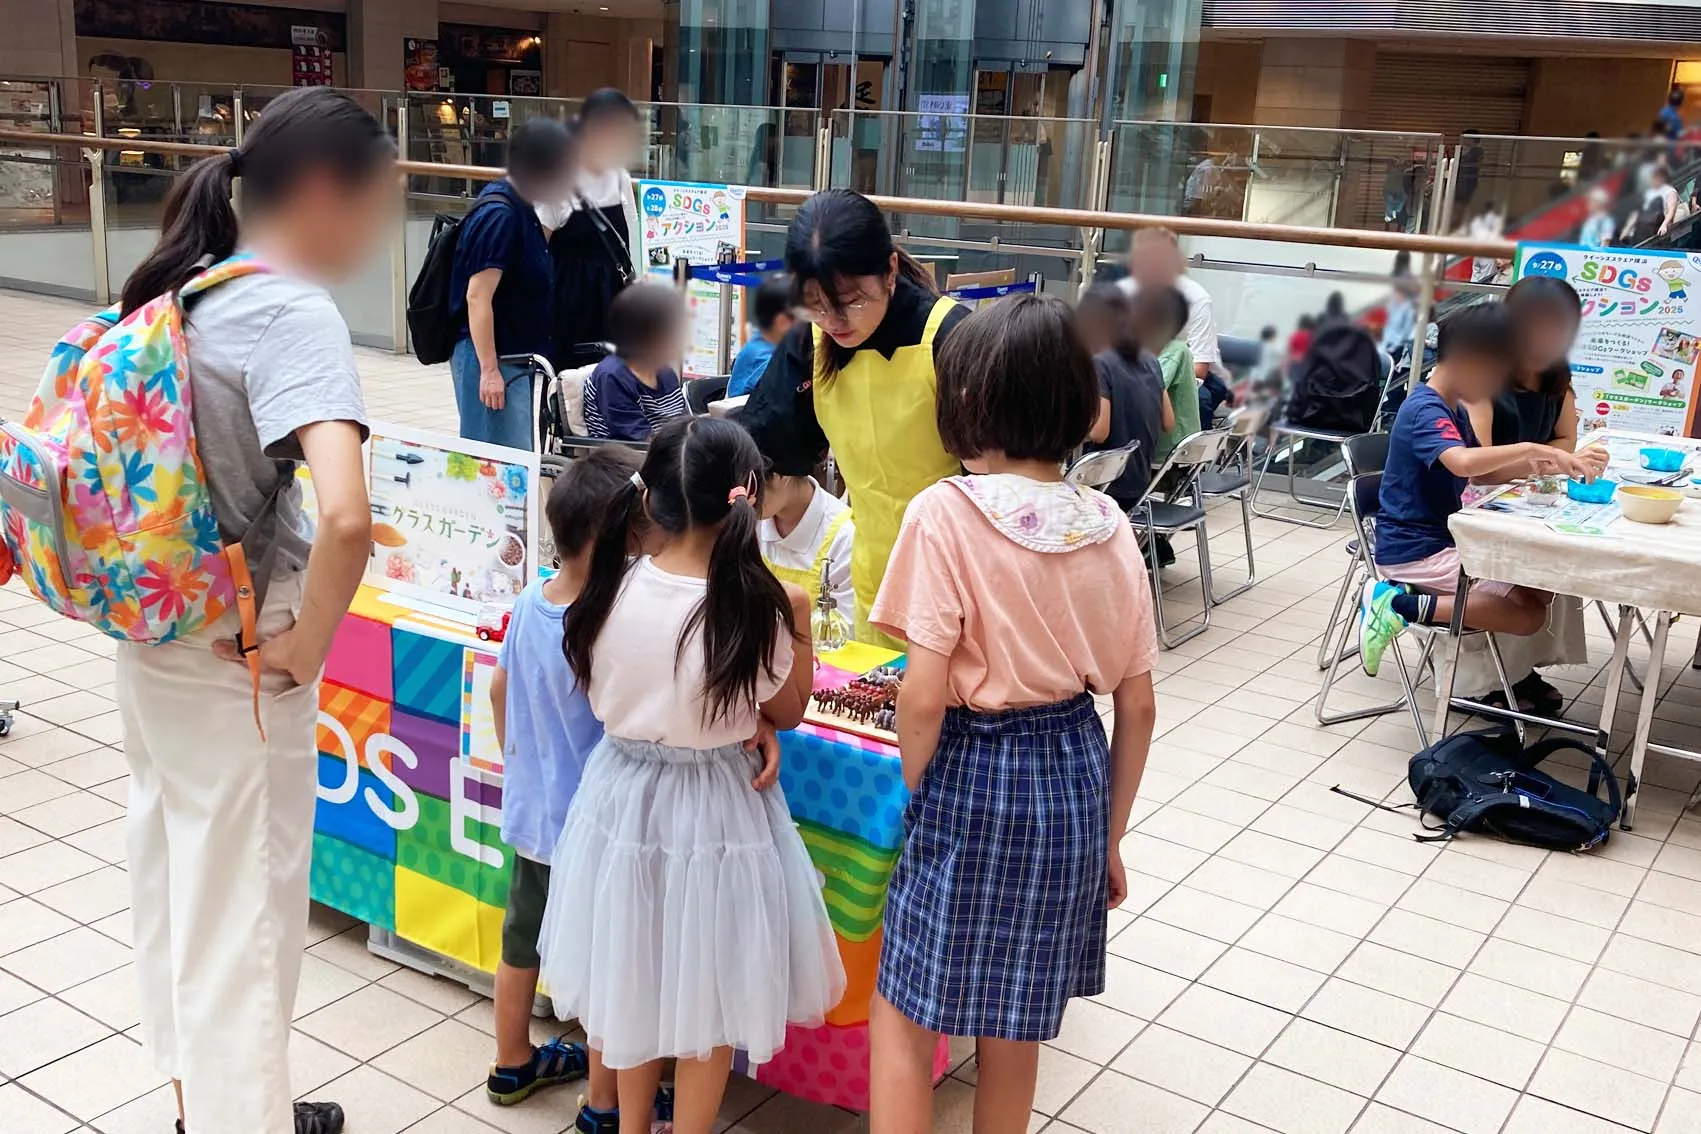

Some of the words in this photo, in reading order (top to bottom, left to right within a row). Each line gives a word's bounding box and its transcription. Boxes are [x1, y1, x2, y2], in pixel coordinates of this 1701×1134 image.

[673, 193, 711, 216] SDGs
[661, 218, 715, 236] アクション
[1581, 261, 1652, 293] SDGs
[1581, 297, 1659, 318] クション
[1659, 305, 1683, 315] 2025
